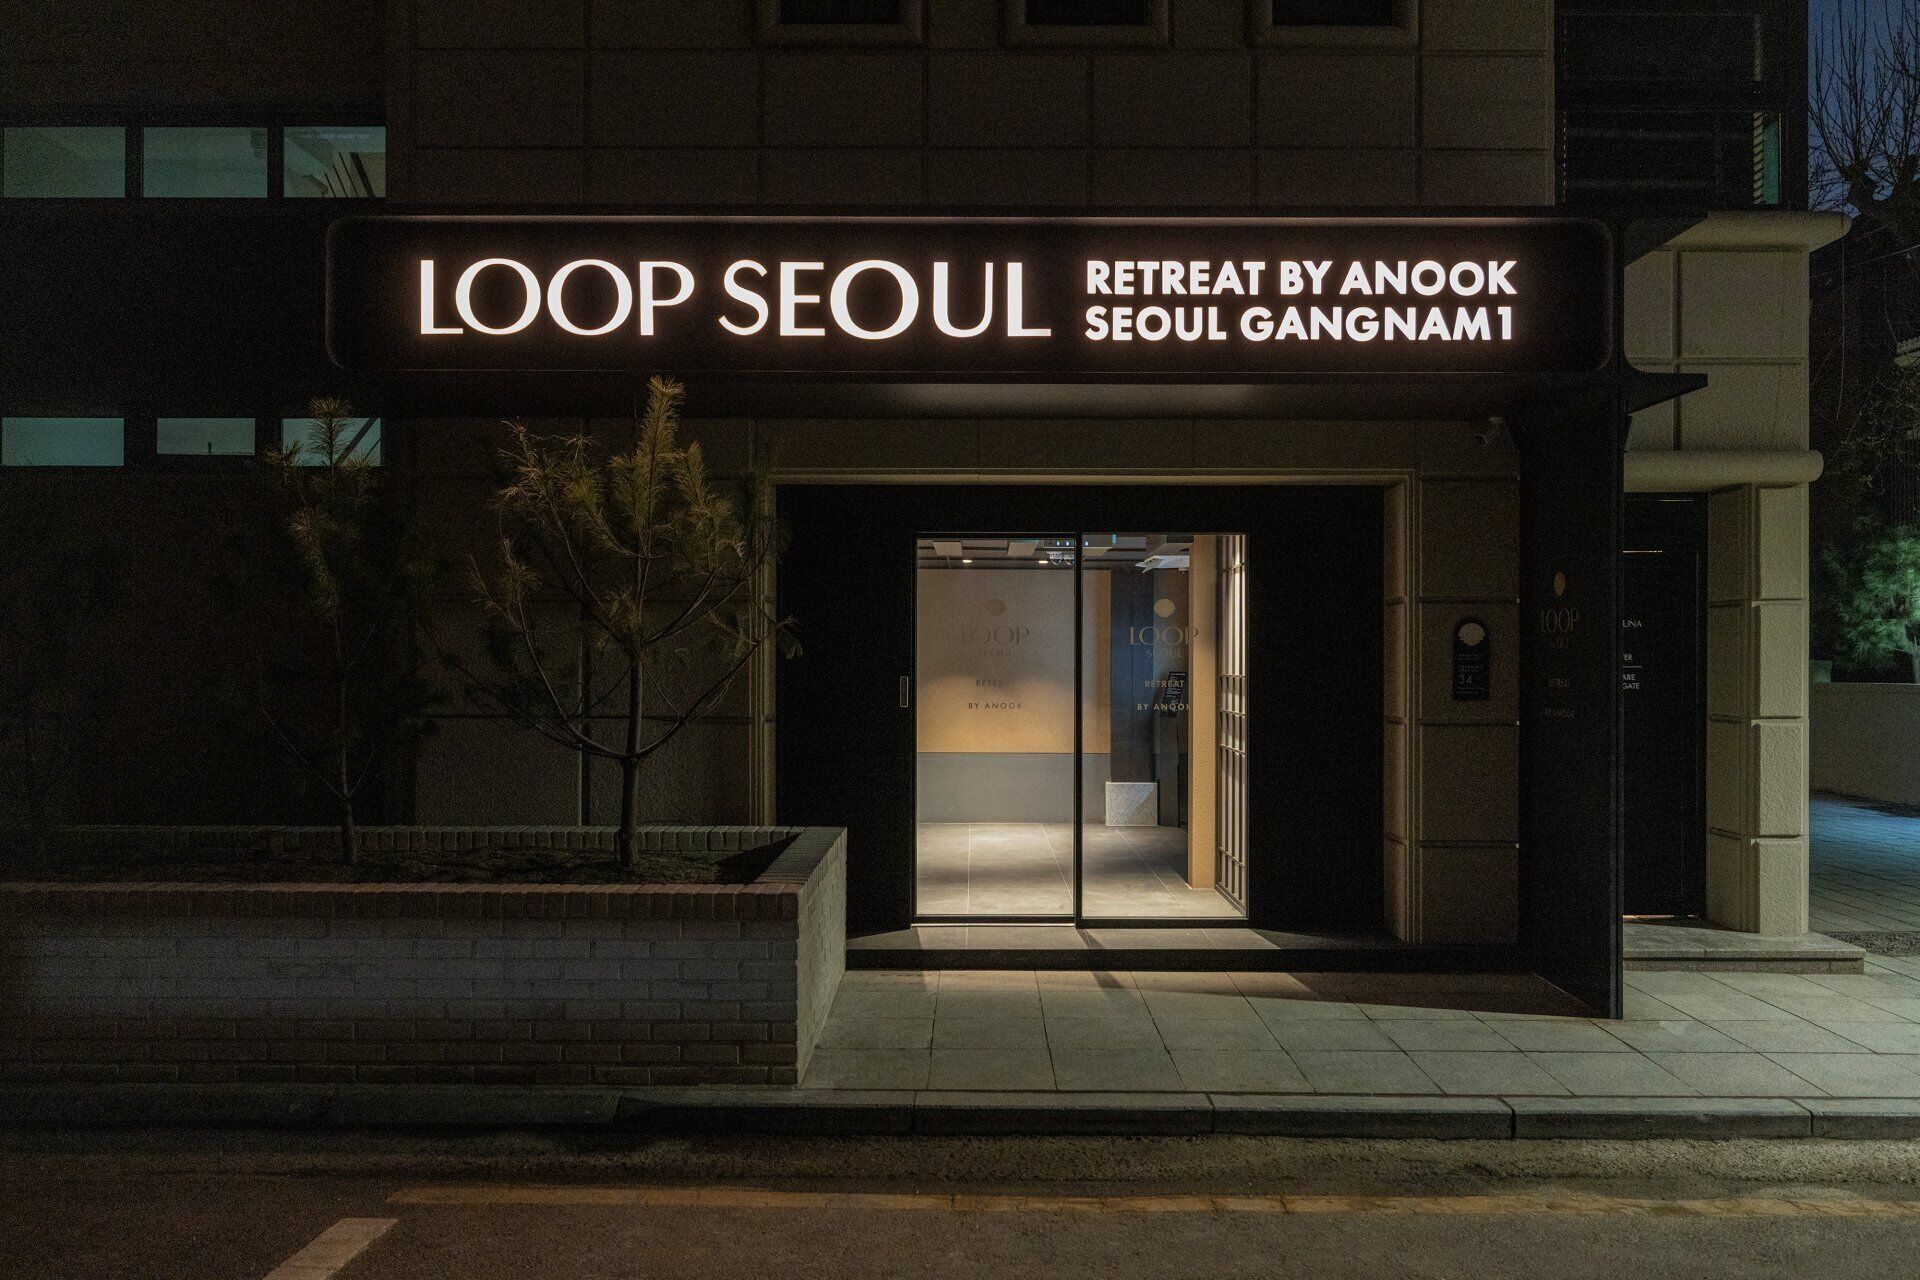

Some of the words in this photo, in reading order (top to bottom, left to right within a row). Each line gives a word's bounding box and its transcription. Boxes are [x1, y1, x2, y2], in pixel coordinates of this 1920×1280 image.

[1087, 260, 1267, 296] RETREAT
[1280, 260, 1333, 296] BY
[1340, 260, 1517, 297] ANOOK
[420, 258, 695, 337] LOOP
[718, 260, 1053, 340] SEOUL
[1084, 305, 1227, 342] SEOUL
[1130, 626, 1199, 646] LOOP
[1144, 680, 1185, 688] RETREAT
[1137, 703, 1149, 711] BY
